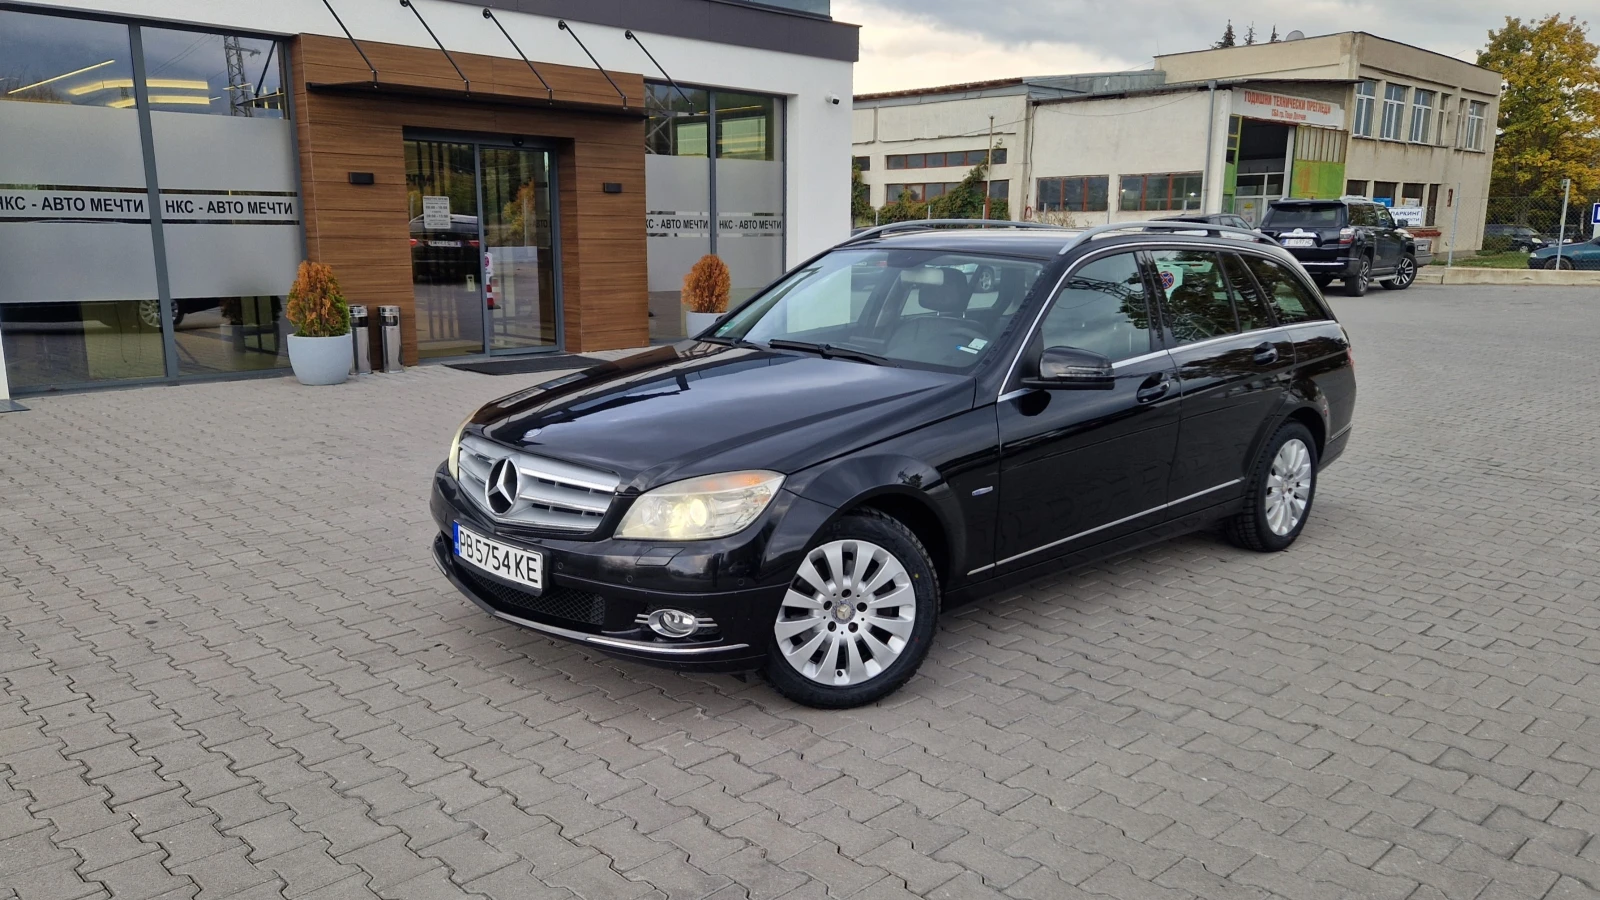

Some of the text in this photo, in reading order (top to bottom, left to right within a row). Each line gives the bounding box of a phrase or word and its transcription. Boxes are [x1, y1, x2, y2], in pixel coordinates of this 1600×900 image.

[1244, 90, 1331, 115] ГОДИШНИ ТЕХНИЧЕСКИ ПРЕГЛЕДИ
[41, 196, 86, 211] АВТО
[90, 198, 144, 213] МЕЧТИ
[165, 200, 194, 214] НКС
[207, 201, 244, 214] АВТО
[247, 202, 293, 215] МЕЧТИ
[660, 219, 682, 229] АВТО
[683, 219, 709, 229] МЕЧТИ
[719, 219, 734, 229] НКС
[739, 220, 758, 230] АВТО
[758, 220, 782, 230] МЕЧТИ
